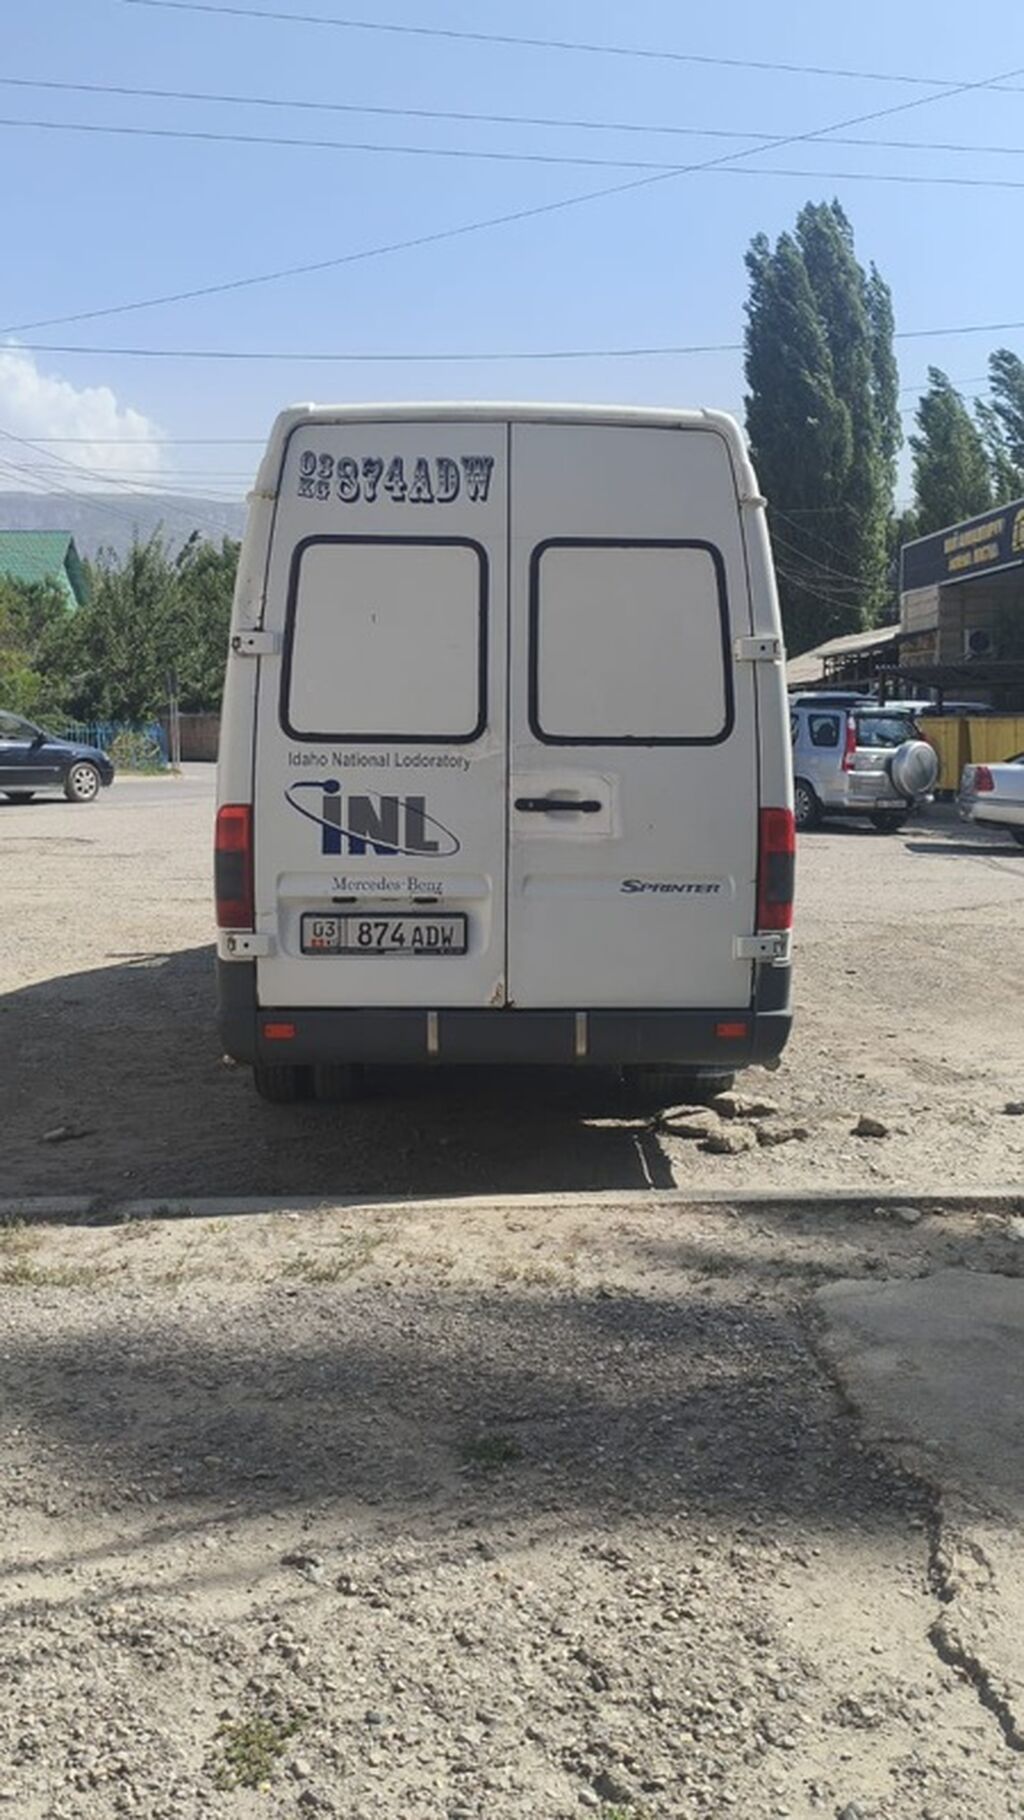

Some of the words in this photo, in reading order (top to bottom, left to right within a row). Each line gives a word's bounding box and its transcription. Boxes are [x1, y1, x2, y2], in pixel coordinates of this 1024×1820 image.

[300, 451, 334, 479] 03
[336, 456, 495, 503] 874ADW
[288, 753, 328, 767] Idaho
[332, 753, 390, 768] National
[313, 921, 335, 937] 03
